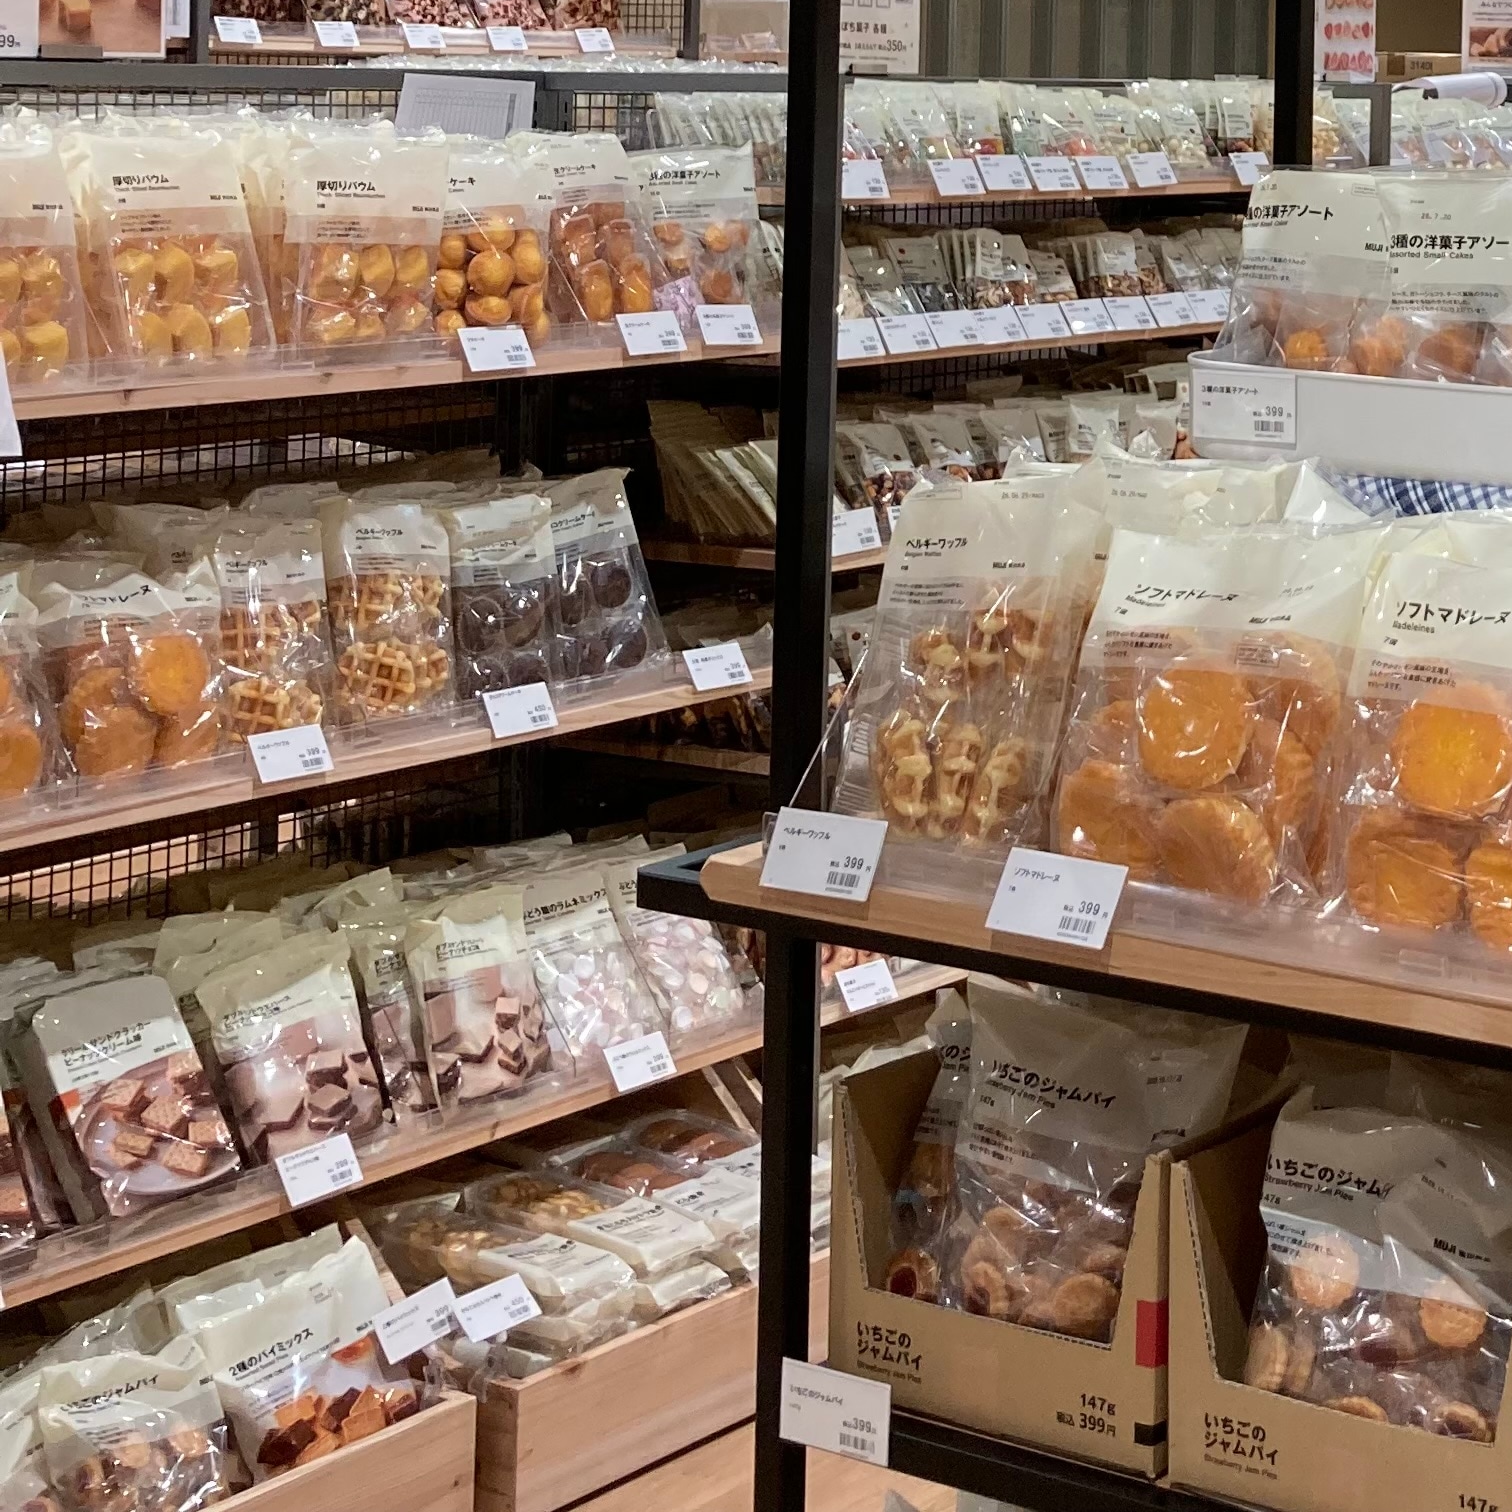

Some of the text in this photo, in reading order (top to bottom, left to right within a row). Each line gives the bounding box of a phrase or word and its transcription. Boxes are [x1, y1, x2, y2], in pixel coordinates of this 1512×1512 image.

[113, 174, 169, 186] 厚切りバウム
[316, 180, 376, 192] 厚切りバウム
[1364, 242, 1384, 253] MUJI
[1265, 405, 1284, 417] 399
[906, 537, 968, 550] ベルギーワッフル
[1134, 584, 1240, 602] ソフトマドレーヌ
[1396, 601, 1512, 625] ソフトマドレーヌ
[1384, 636, 1399, 646] 7個
[783, 827, 831, 841] ベルギーワッフル
[843, 855, 864, 870] 399
[1078, 900, 1101, 916] 399
[1433, 1237, 1457, 1255] MUJI
[856, 1320, 912, 1350] いちごの
[229, 1327, 314, 1377] 2種のパイミックス
[857, 1339, 923, 1371] ジャムパイ
[1080, 1392, 1117, 1417] 147g
[1079, 1412, 1117, 1438] 399円
[1204, 1412, 1266, 1442] いちごの
[1204, 1431, 1279, 1466] ジャムパイ
